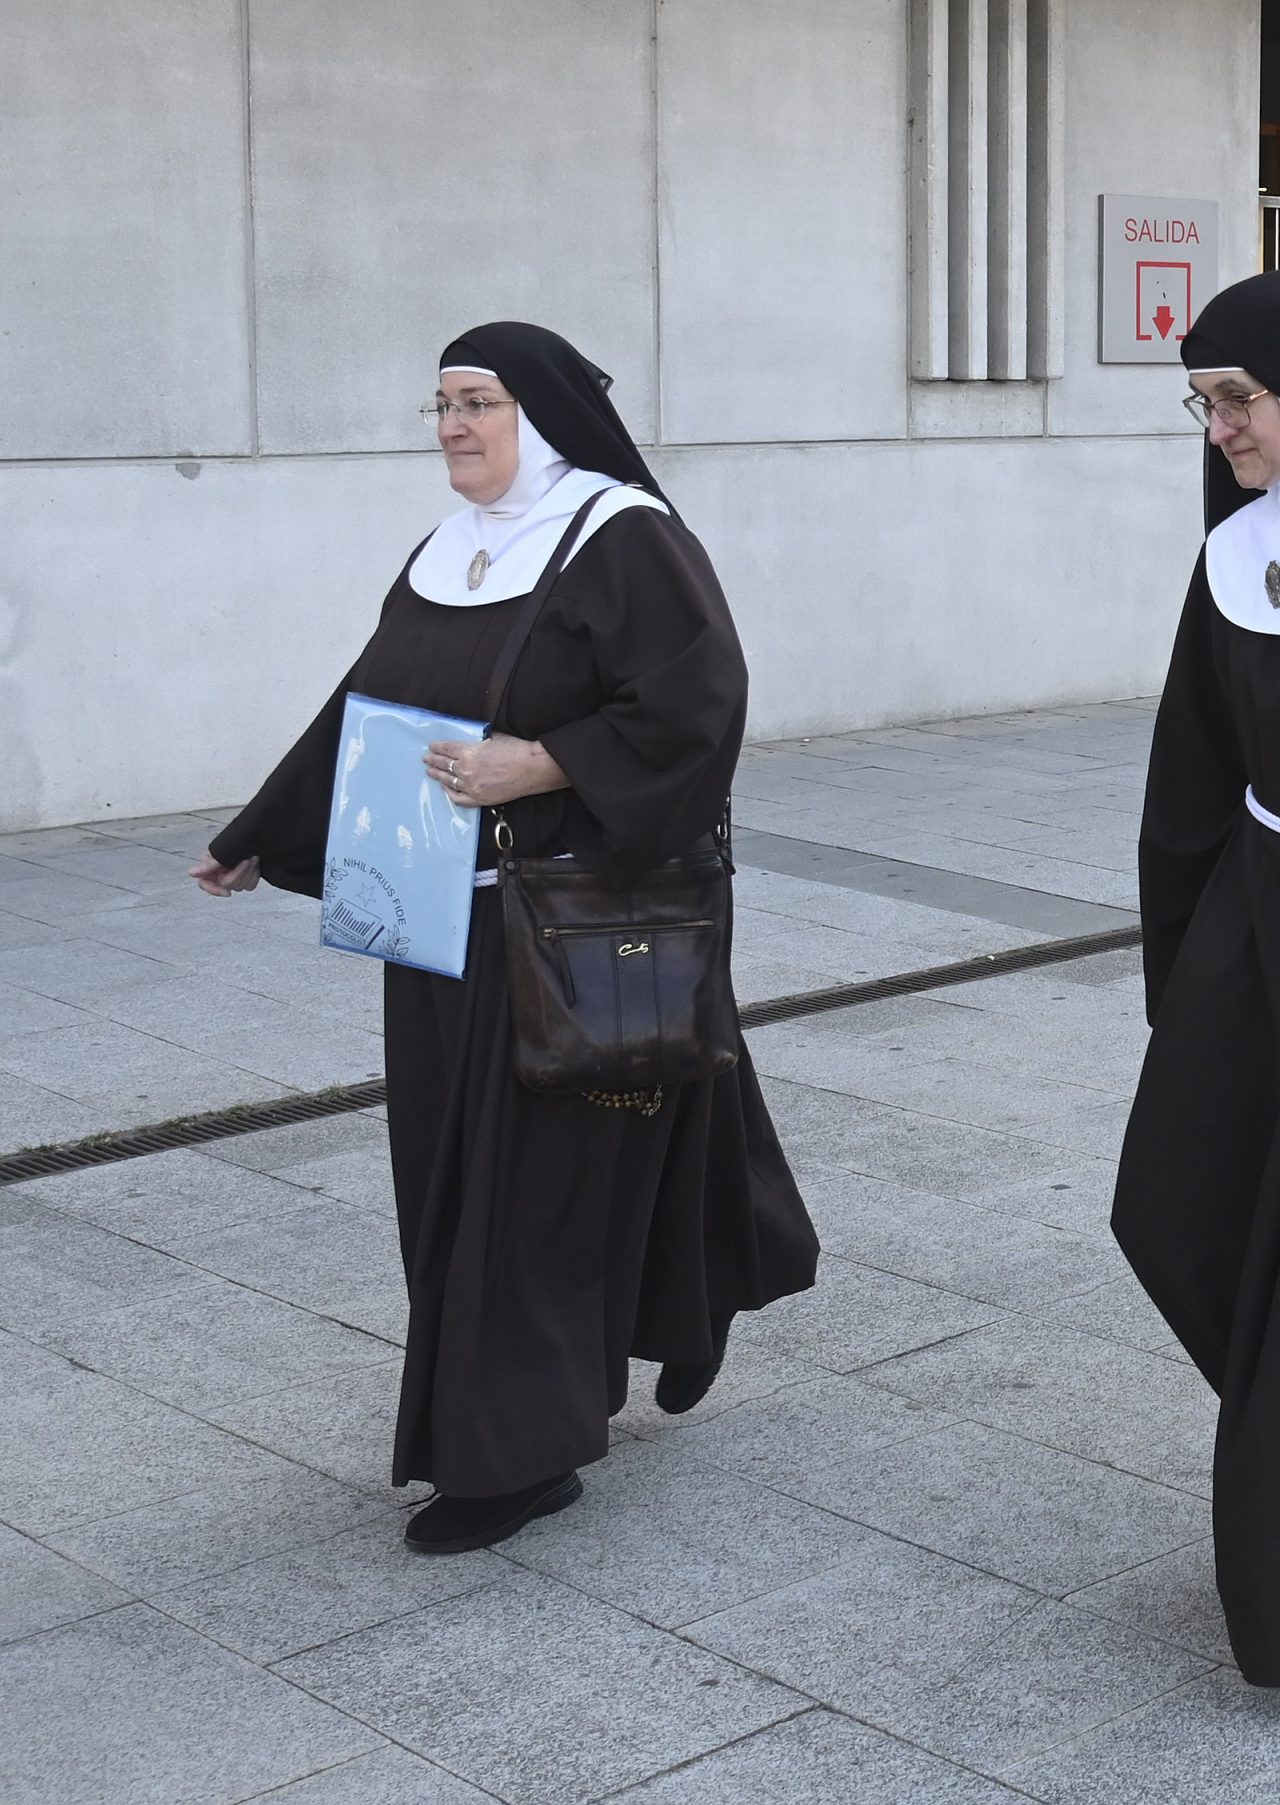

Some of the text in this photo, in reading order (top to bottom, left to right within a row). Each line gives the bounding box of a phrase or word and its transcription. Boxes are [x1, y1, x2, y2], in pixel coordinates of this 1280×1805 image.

[1124, 218, 1200, 244] SALIDA
[343, 858, 406, 926] NIHIL PRIUS FIDE
